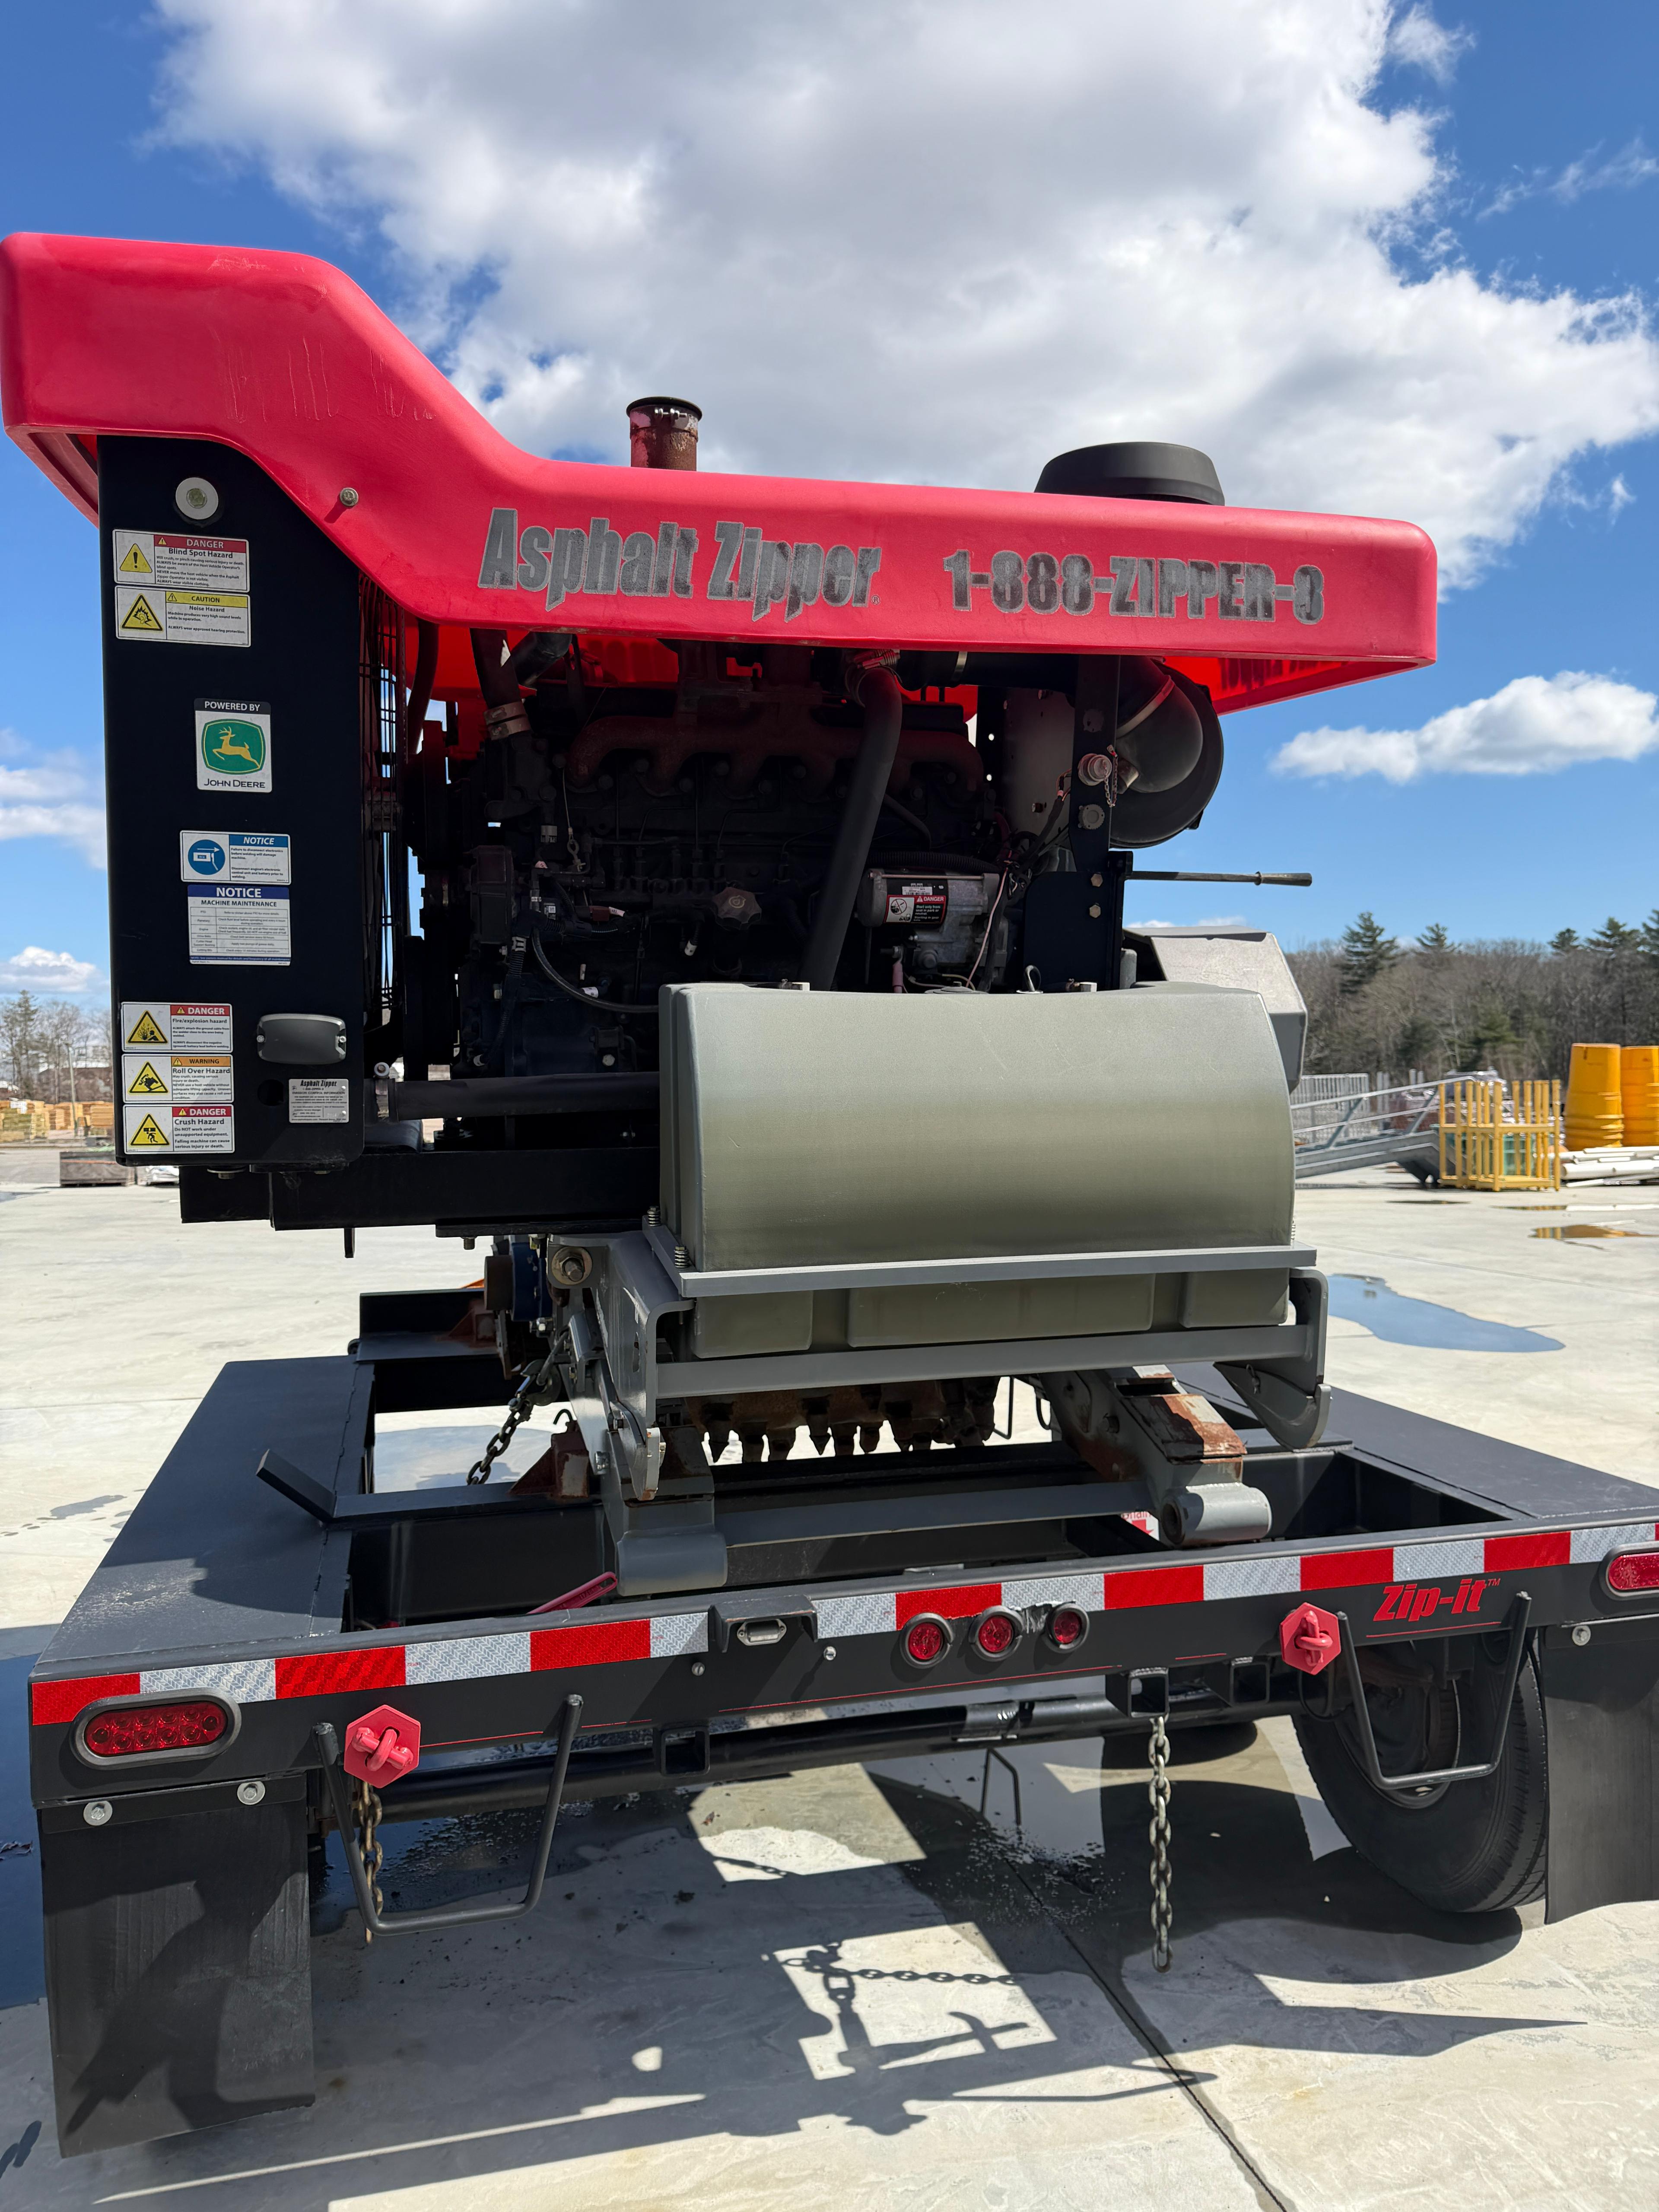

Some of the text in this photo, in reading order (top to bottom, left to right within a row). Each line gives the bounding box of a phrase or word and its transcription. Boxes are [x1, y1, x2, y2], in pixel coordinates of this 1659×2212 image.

[187, 539, 223, 548] DANGER
[478, 508, 699, 611] Asphalt
[944, 550, 1324, 625] 1-888-ZIPPER-8
[205, 701, 247, 711] POWERED
[204, 779, 265, 788] JOHN DEERE
[244, 837, 274, 845] NOTICE
[216, 888, 261, 899] NOTICE
